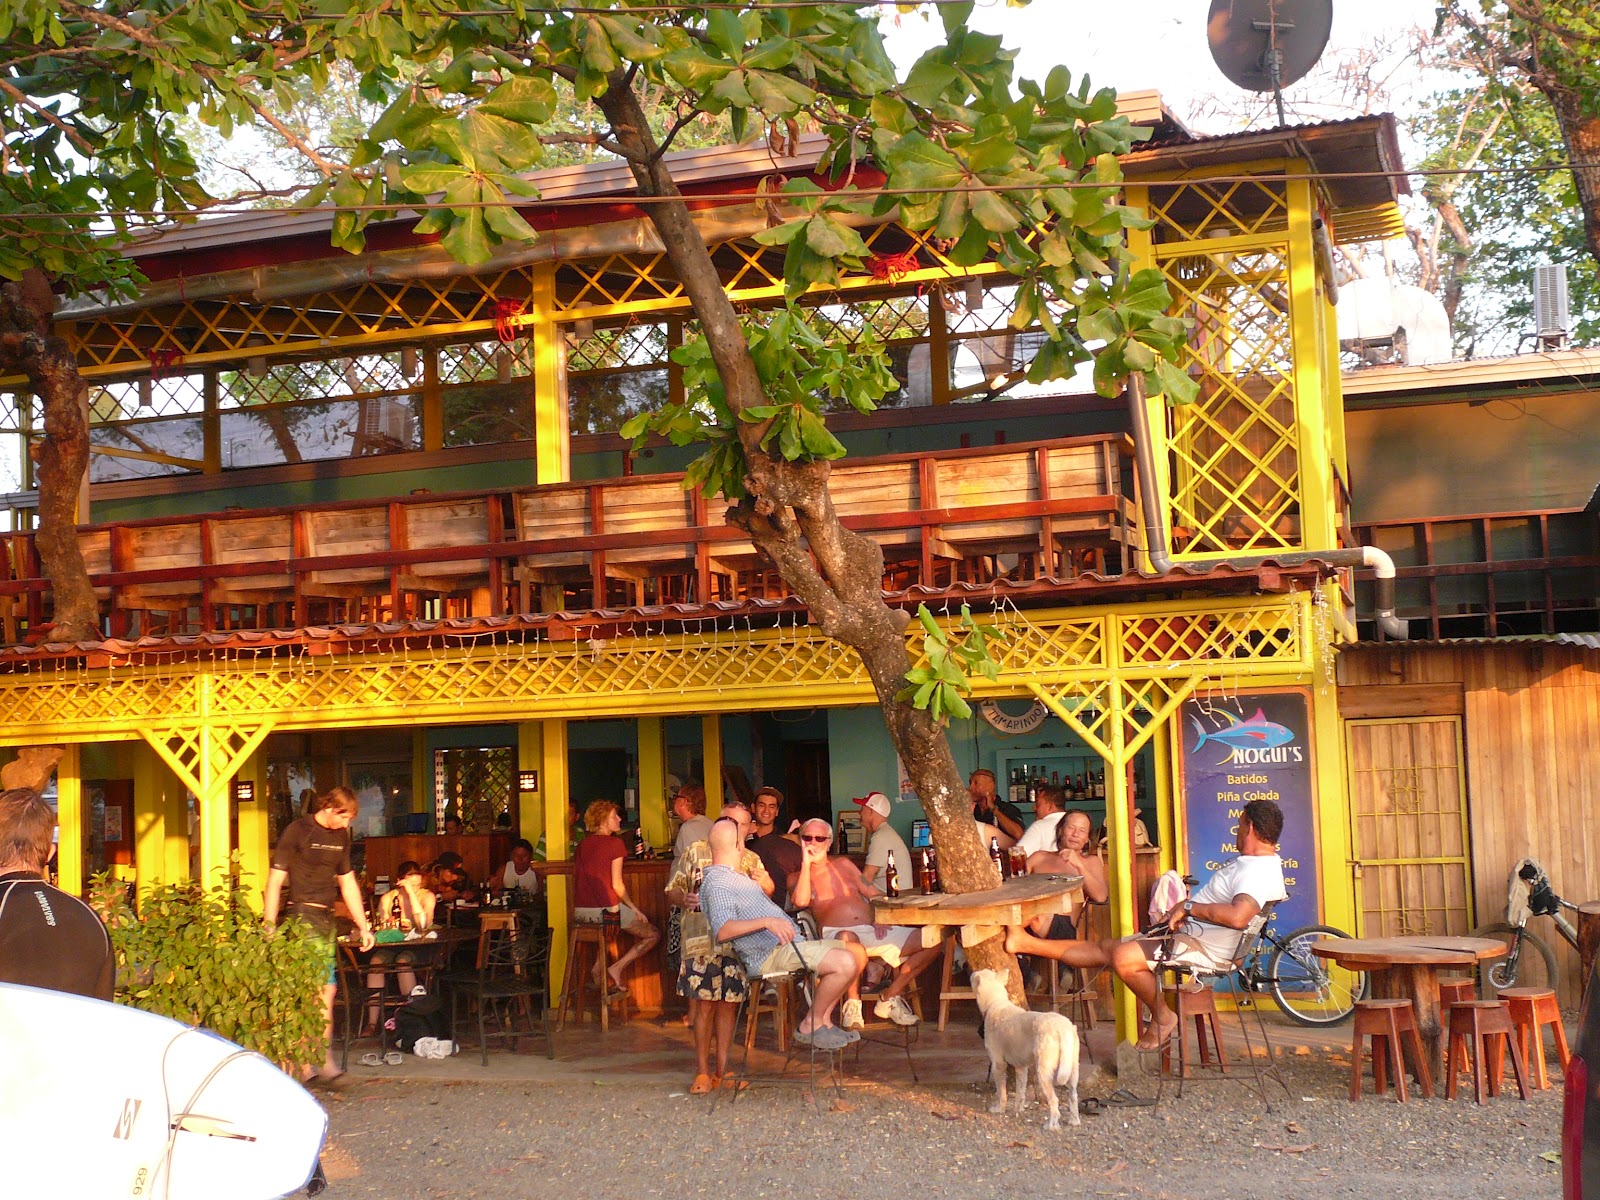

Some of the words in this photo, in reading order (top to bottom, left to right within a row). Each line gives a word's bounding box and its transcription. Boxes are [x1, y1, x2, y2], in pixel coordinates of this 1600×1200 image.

[988, 708, 1042, 730] TAMARINDO
[1233, 746, 1303, 764] NOGUI'S
[1227, 773, 1268, 785] Batidos
[1217, 791, 1241, 802] Piña
[1243, 789, 1280, 801] Colada
[132, 1167, 148, 1195] 929
